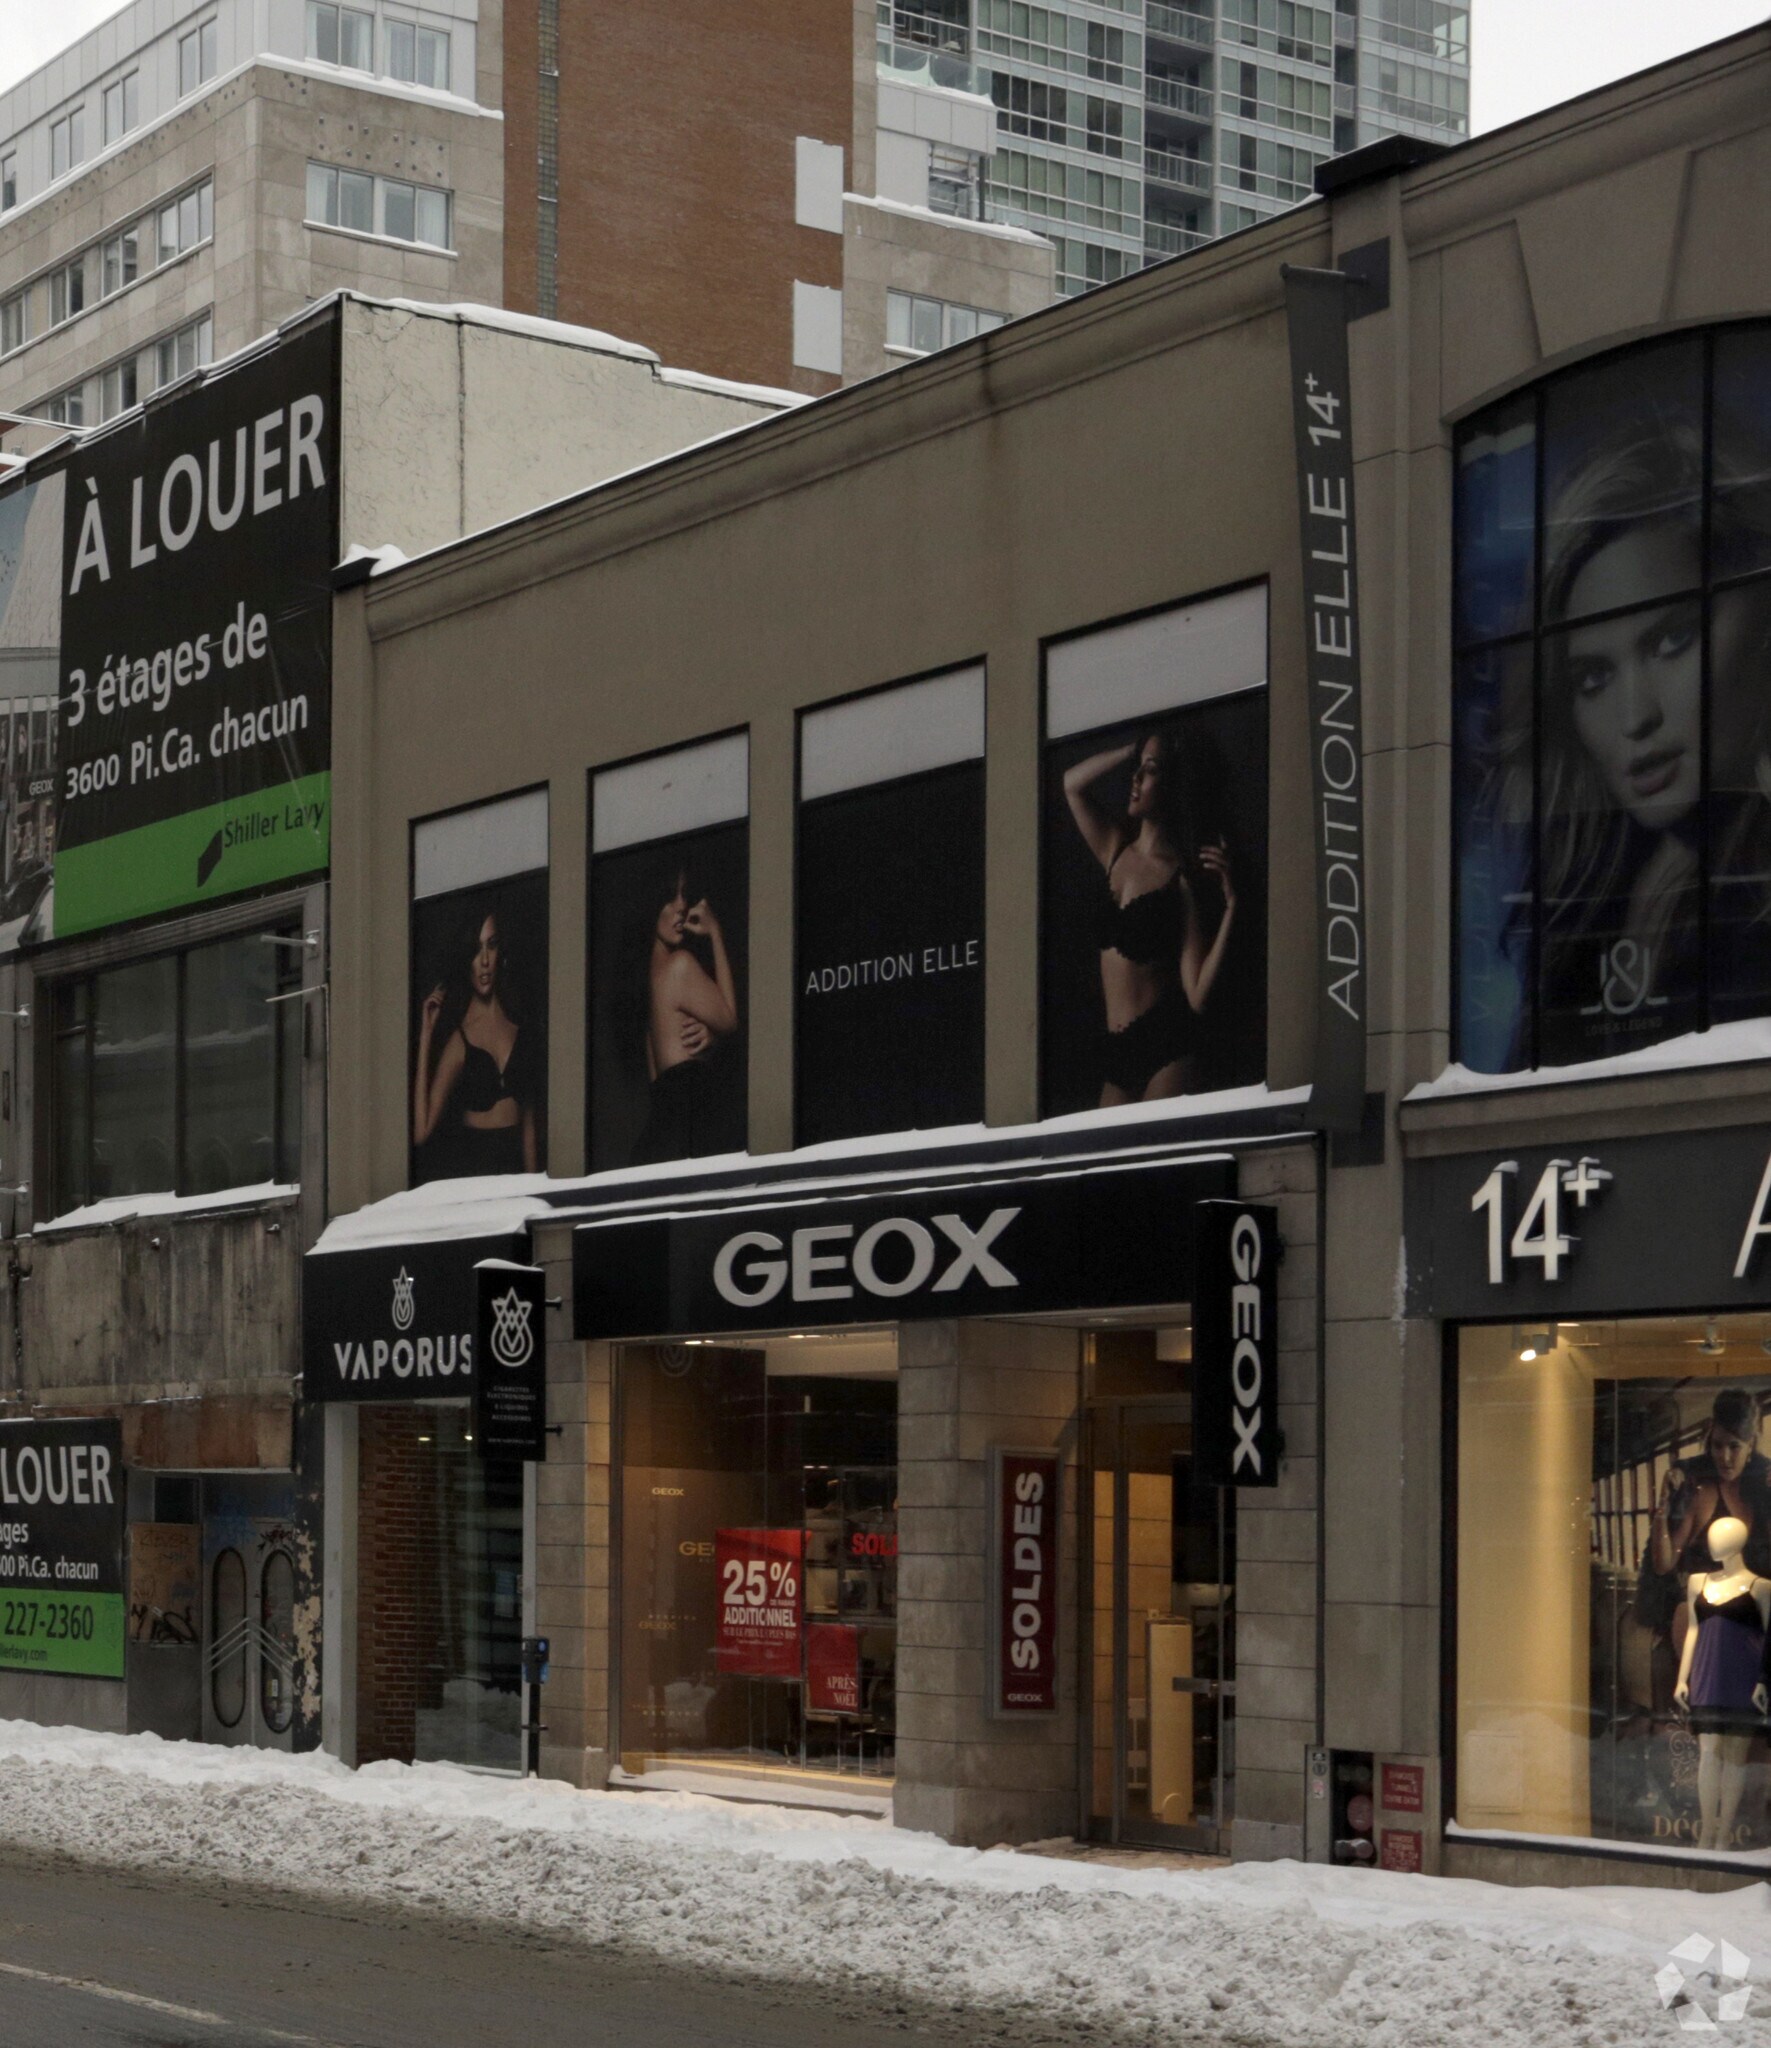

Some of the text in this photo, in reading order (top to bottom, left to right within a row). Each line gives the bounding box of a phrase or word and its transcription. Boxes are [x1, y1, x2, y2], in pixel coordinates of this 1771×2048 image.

[69, 393, 326, 596] À LOUER
[1307, 473, 1351, 658] ELLE
[67, 601, 269, 728] 3 étages de
[65, 693, 309, 800] 3600 Pi.Ca. chacun
[29, 778, 54, 796] GEOX
[223, 801, 326, 849] Shiller Lavy
[1318, 679, 1360, 1021] ADDITION
[805, 939, 979, 995] ADDITION ELLE
[713, 1206, 1023, 1308] GEOX
[333, 1333, 472, 1380] VAPORUS
[1231, 1213, 1262, 1476] GEOX
[1, 1445, 114, 1505] LOUER
[652, 1487, 685, 1496] GEOX
[18, 1554, 51, 1578] Pi.Ca.
[55, 1555, 98, 1580] chacun
[679, 1541, 715, 1556] GE
[1010, 1472, 1044, 1670] SOLDES
[723, 1559, 796, 1606] 25%
[1007, 1693, 1043, 1702] GEOX
